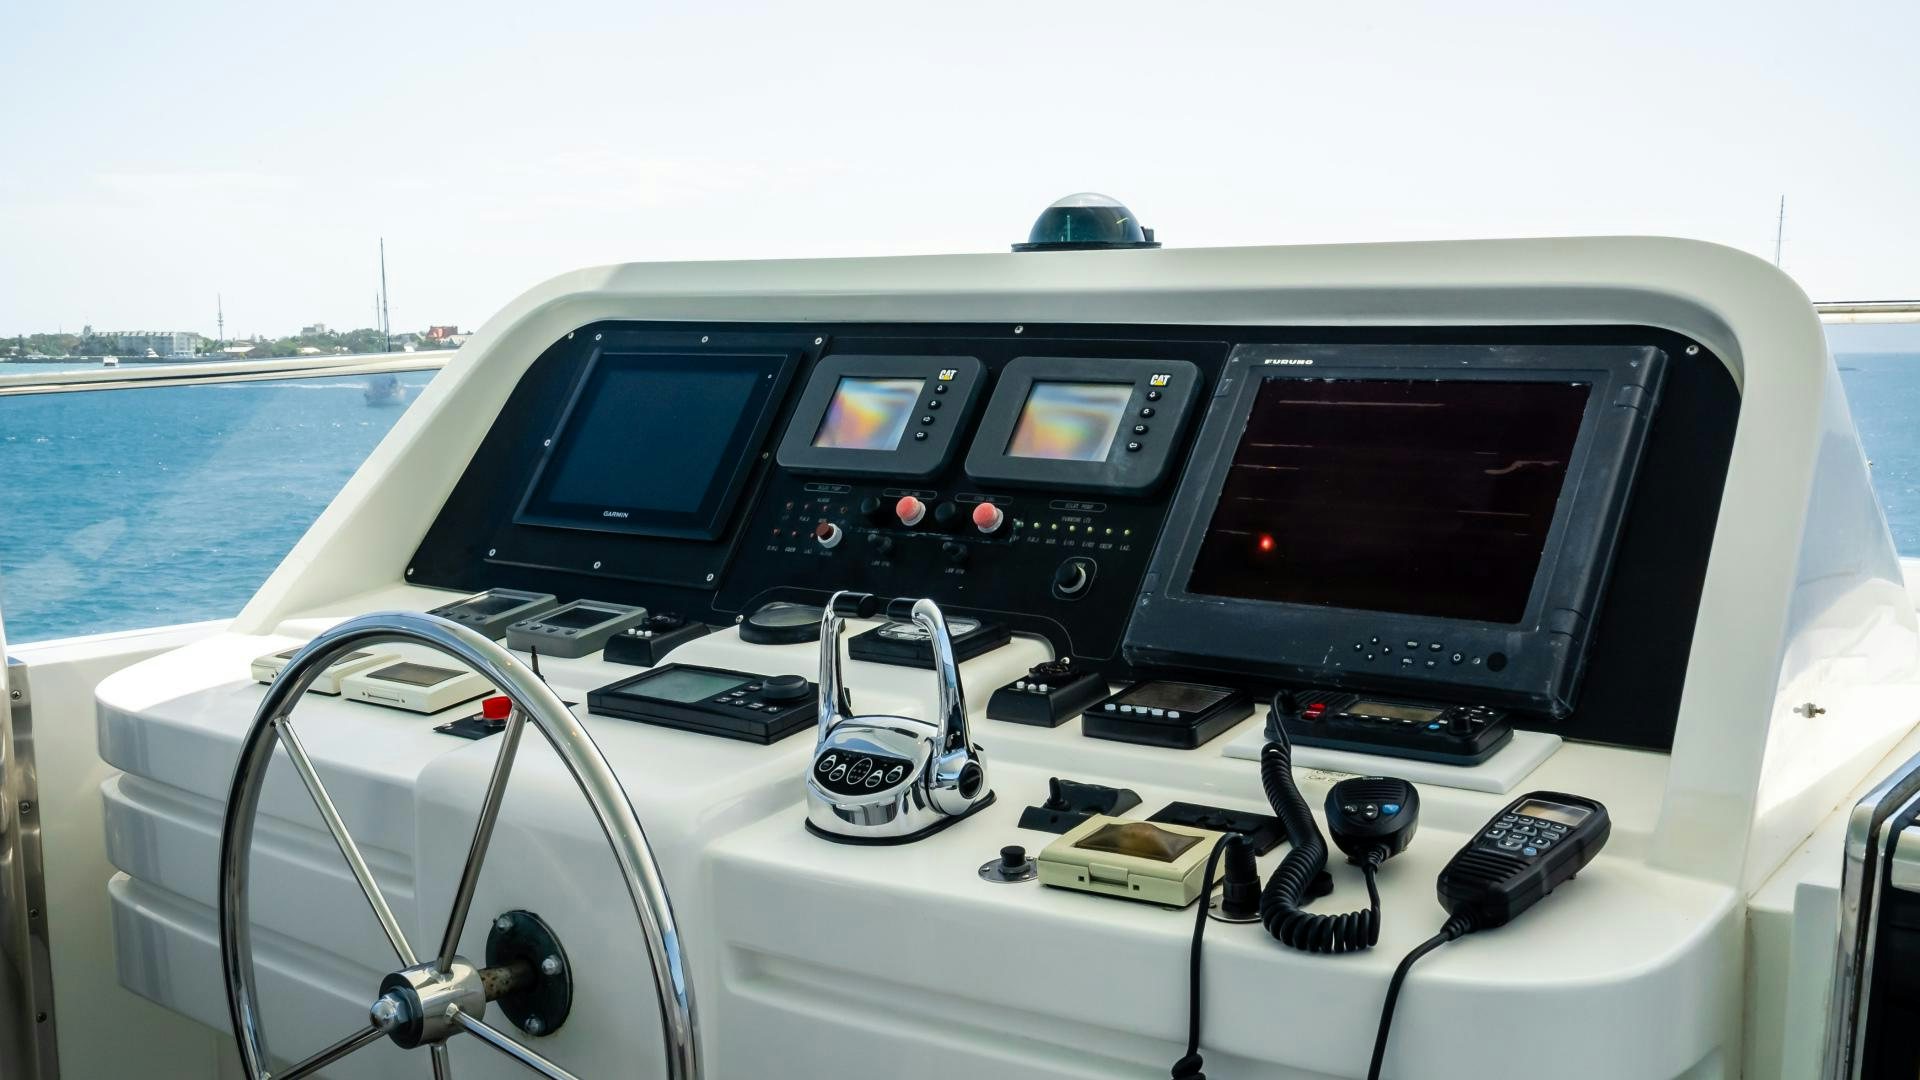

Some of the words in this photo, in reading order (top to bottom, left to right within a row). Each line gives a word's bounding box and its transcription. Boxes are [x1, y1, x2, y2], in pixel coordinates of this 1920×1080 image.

[938, 369, 957, 380] CAT
[1150, 374, 1171, 386] CAT
[603, 510, 630, 519] GARMIN
